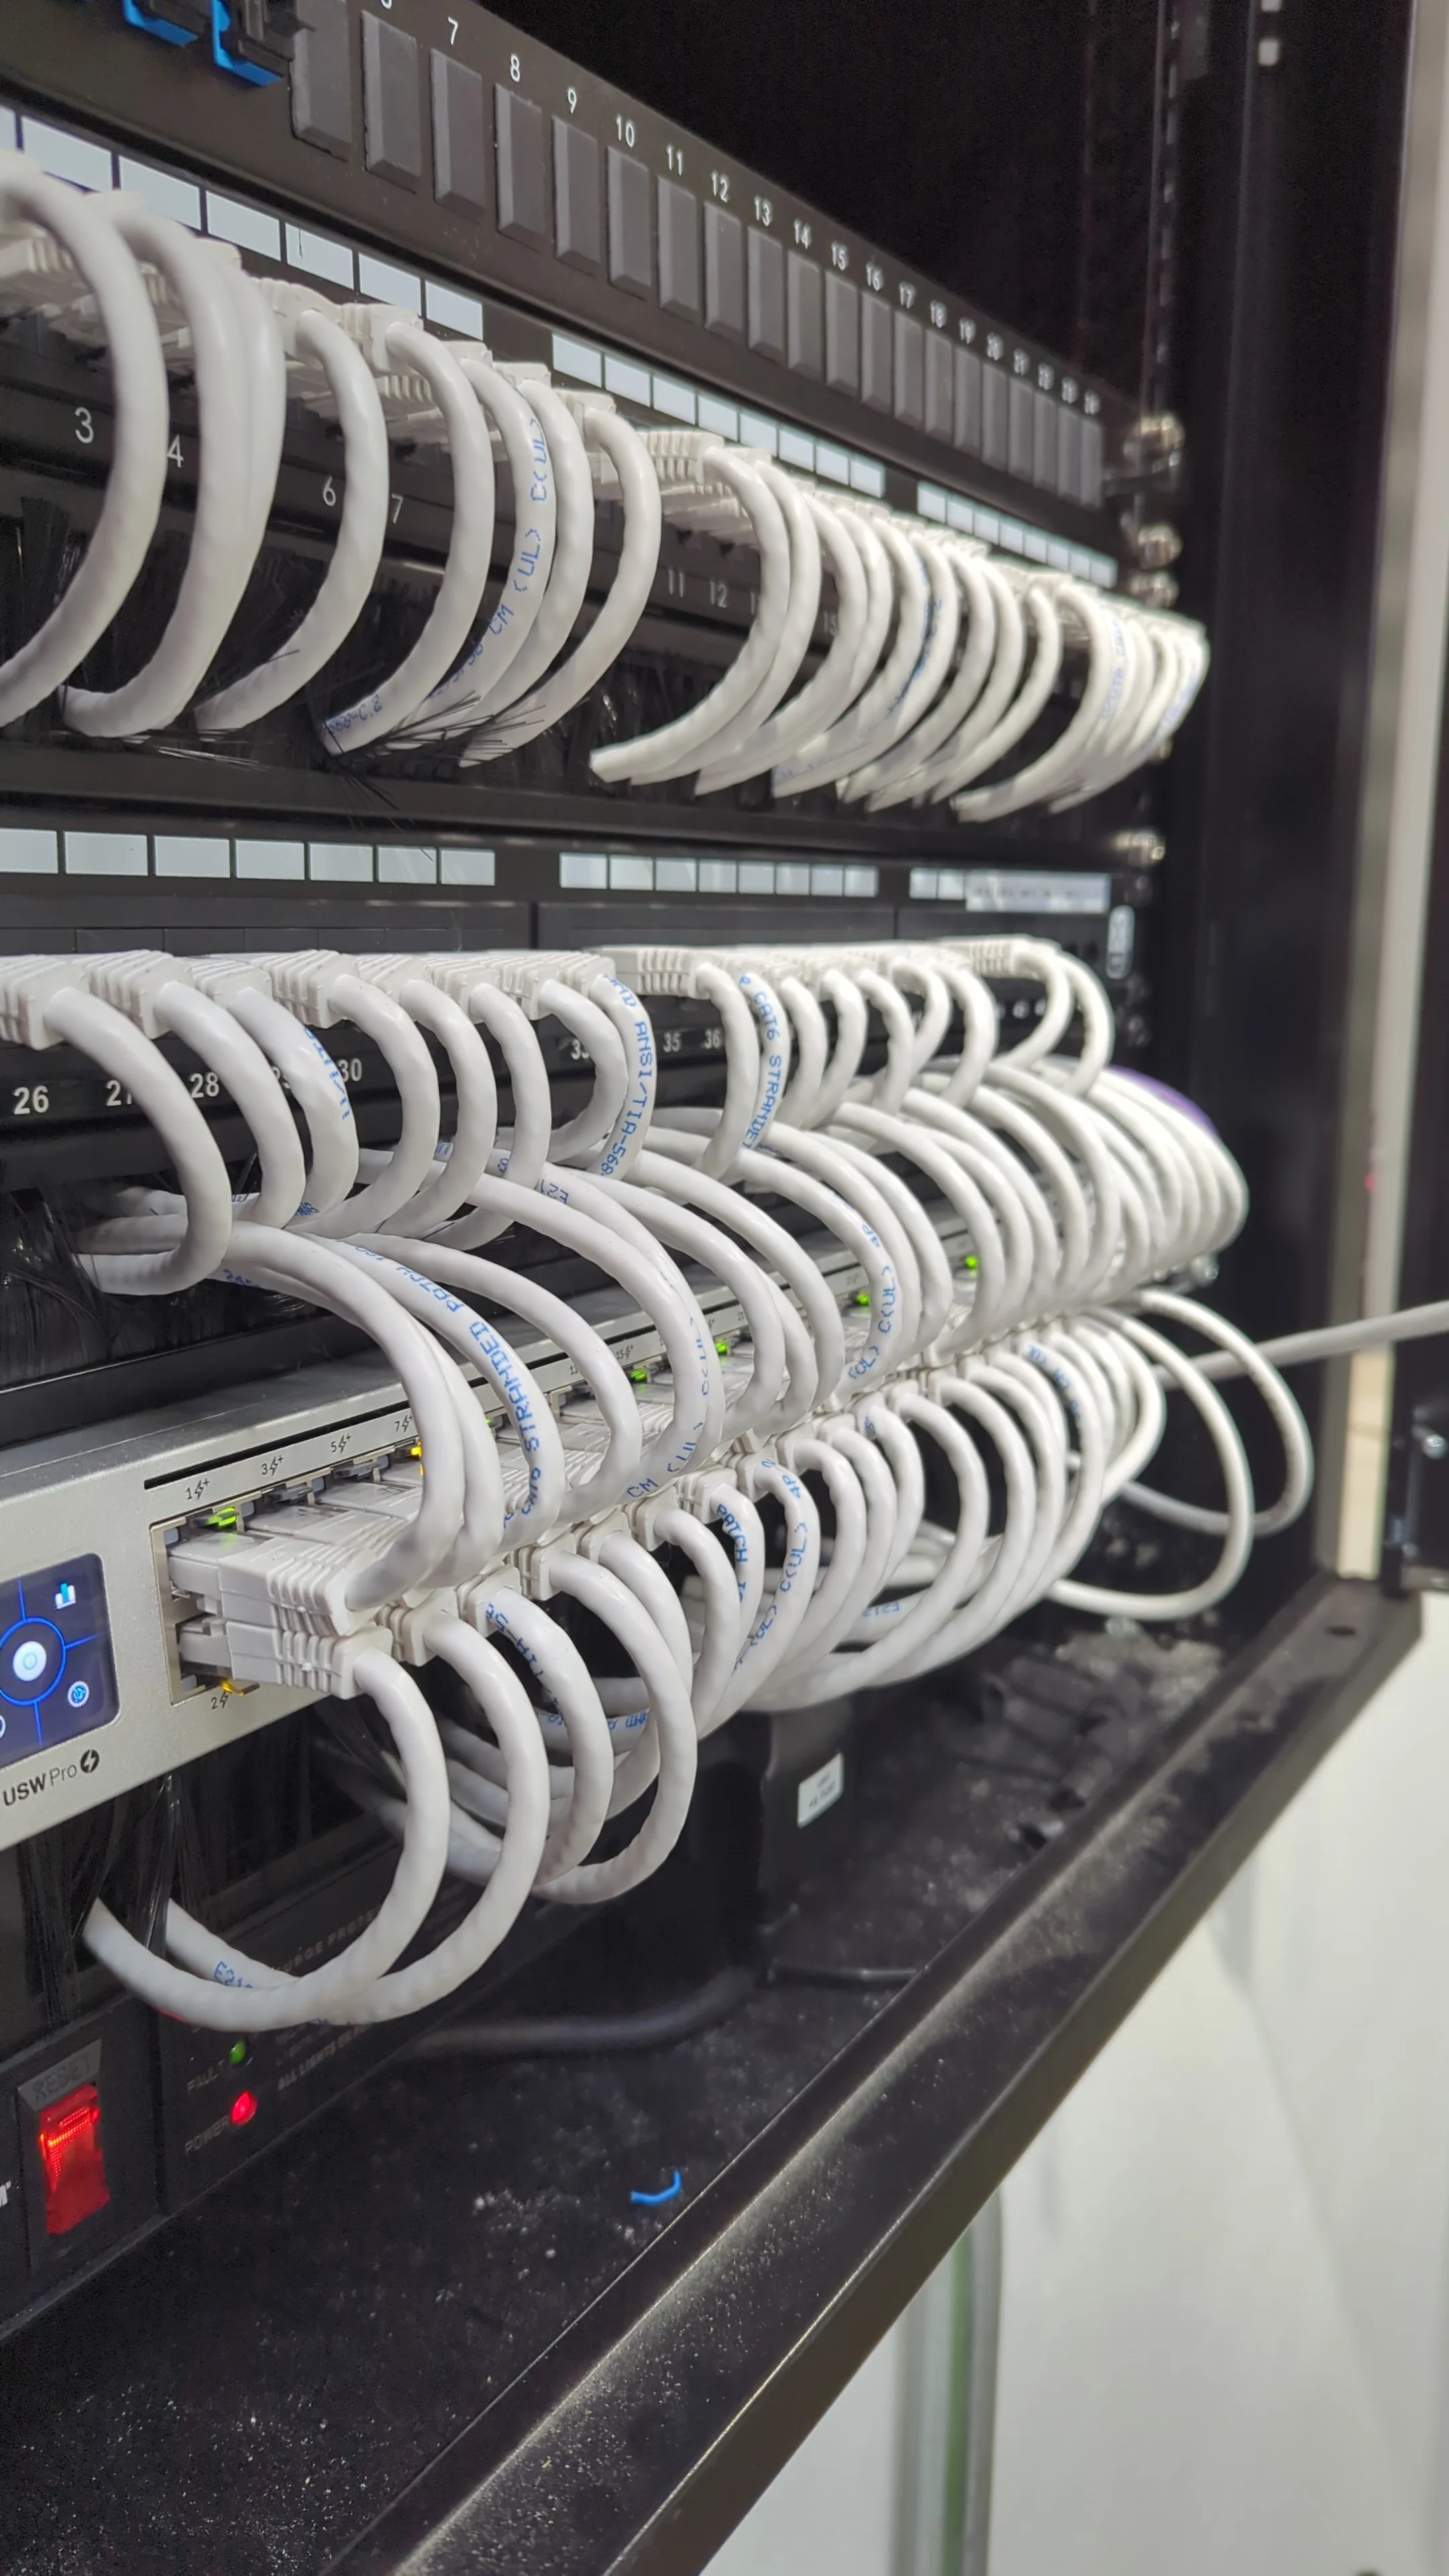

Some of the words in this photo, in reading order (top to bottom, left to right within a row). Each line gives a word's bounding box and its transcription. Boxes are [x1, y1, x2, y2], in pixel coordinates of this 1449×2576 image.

[447, 17, 459, 45] 7
[510, 54, 521, 82] 8
[567, 87, 578, 113] 9
[615, 113, 635, 148] 10
[665, 145, 684, 176] 11
[711, 170, 729, 203] 12
[754, 195, 771, 226] 13
[794, 218, 810, 249] 14
[831, 241, 848, 271] 15
[866, 261, 883, 291] 16
[899, 281, 916, 309] 17
[74, 407, 94, 444] 3
[166, 435, 184, 468] 4
[323, 475, 336, 507] 6
[391, 494, 404, 524] 7
[668, 568, 684, 598] 11
[710, 579, 727, 608] 12
[663, 1032, 682, 1053] 35
[704, 1029, 721, 1050] 36
[191, 1072, 220, 1099] 28
[337, 1058, 363, 1083] 30
[13, 1085, 50, 1115] 26
[394, 1420, 400, 1432] 7
[331, 1441, 337, 1453] 5
[261, 1463, 268, 1475] 3
[185, 1487, 192, 1500] 1
[627, 1478, 659, 1499] CM
[717, 1503, 748, 1562] PATCH
[211, 1696, 220, 1710] 2
[3, 1772, 46, 1806] USW
[49, 1764, 78, 1786] Pro
[276, 1940, 324, 1972] URGE
[327, 1905, 380, 1947] PROTE
[214, 1961, 252, 1988] E21
[185, 2114, 230, 2155] POWER
